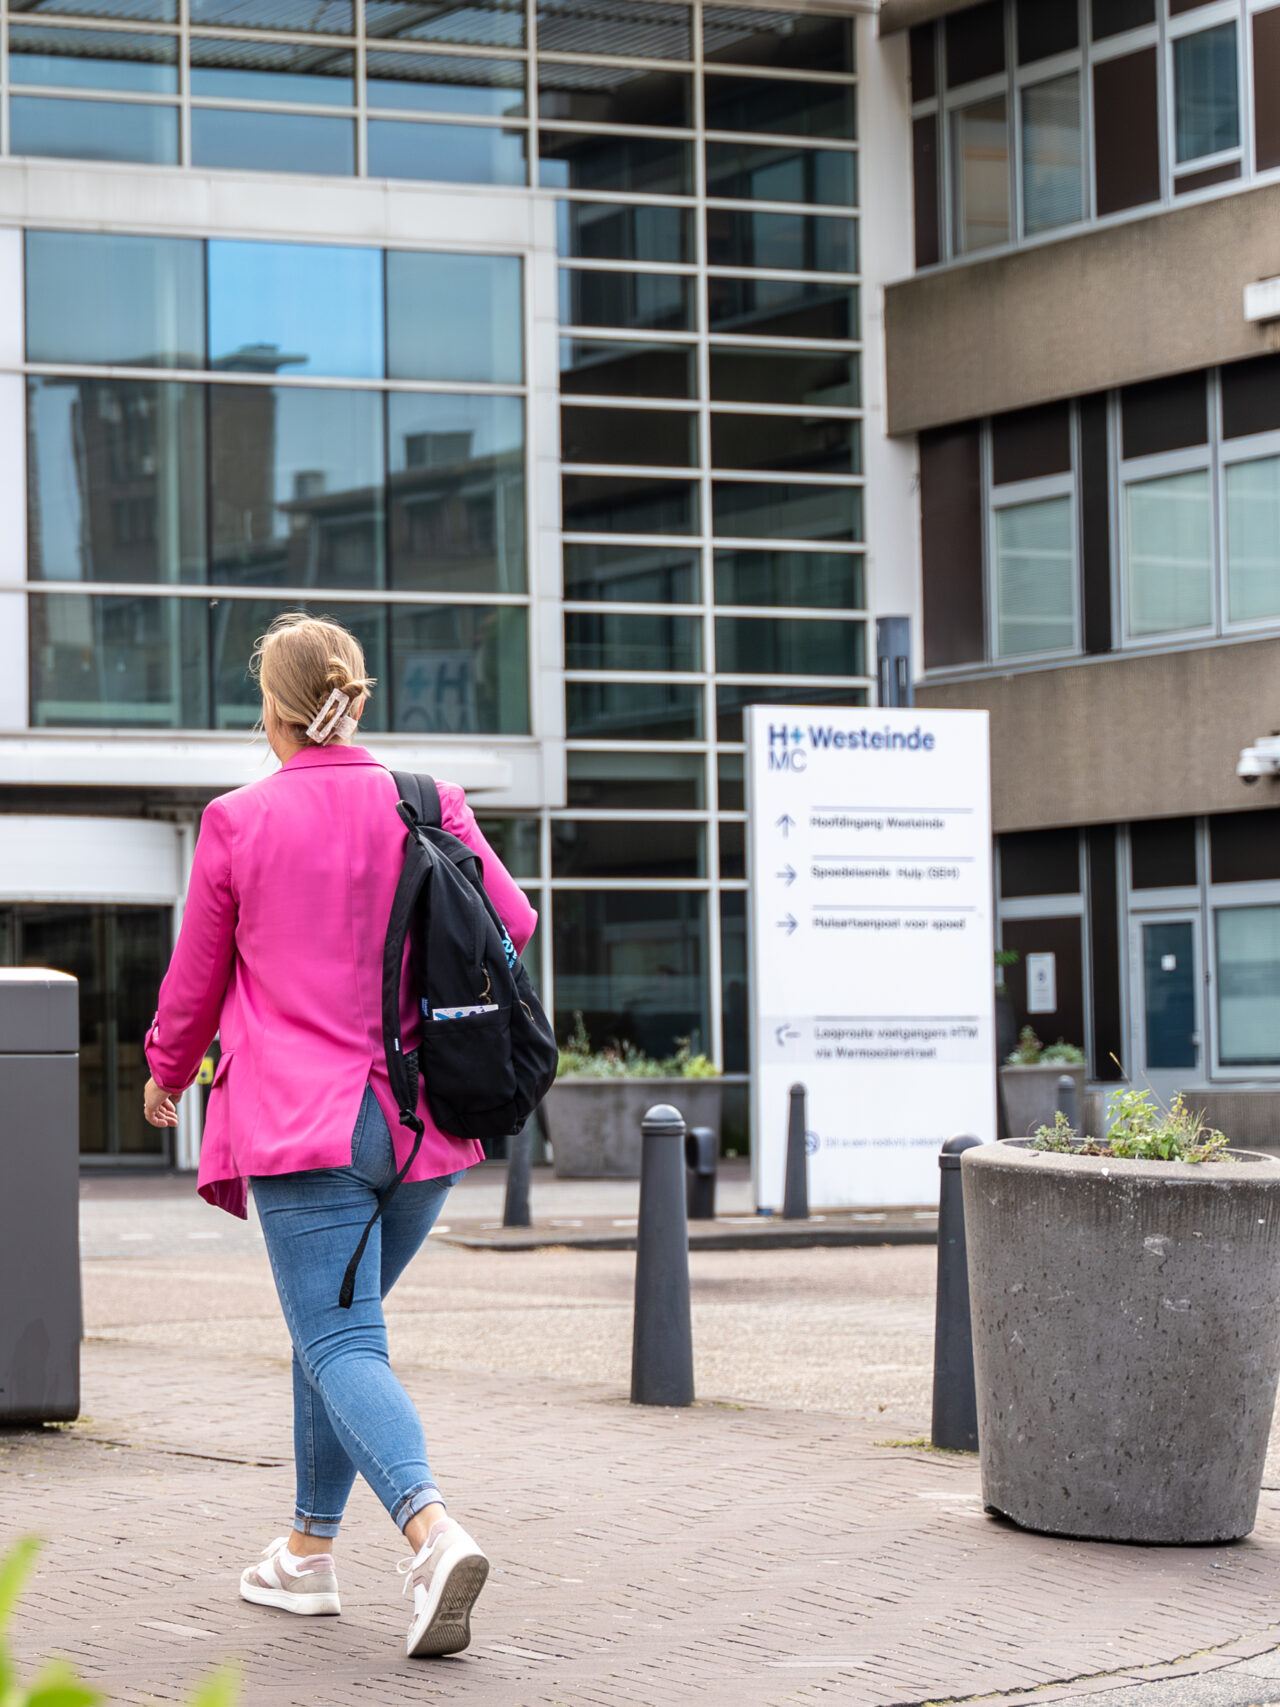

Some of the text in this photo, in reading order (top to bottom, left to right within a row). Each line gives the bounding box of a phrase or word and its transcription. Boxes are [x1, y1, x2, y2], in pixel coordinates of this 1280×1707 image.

[808, 726, 935, 751] Westeinde
[768, 749, 807, 772] MC
[886, 817, 945, 829] Westeinde
